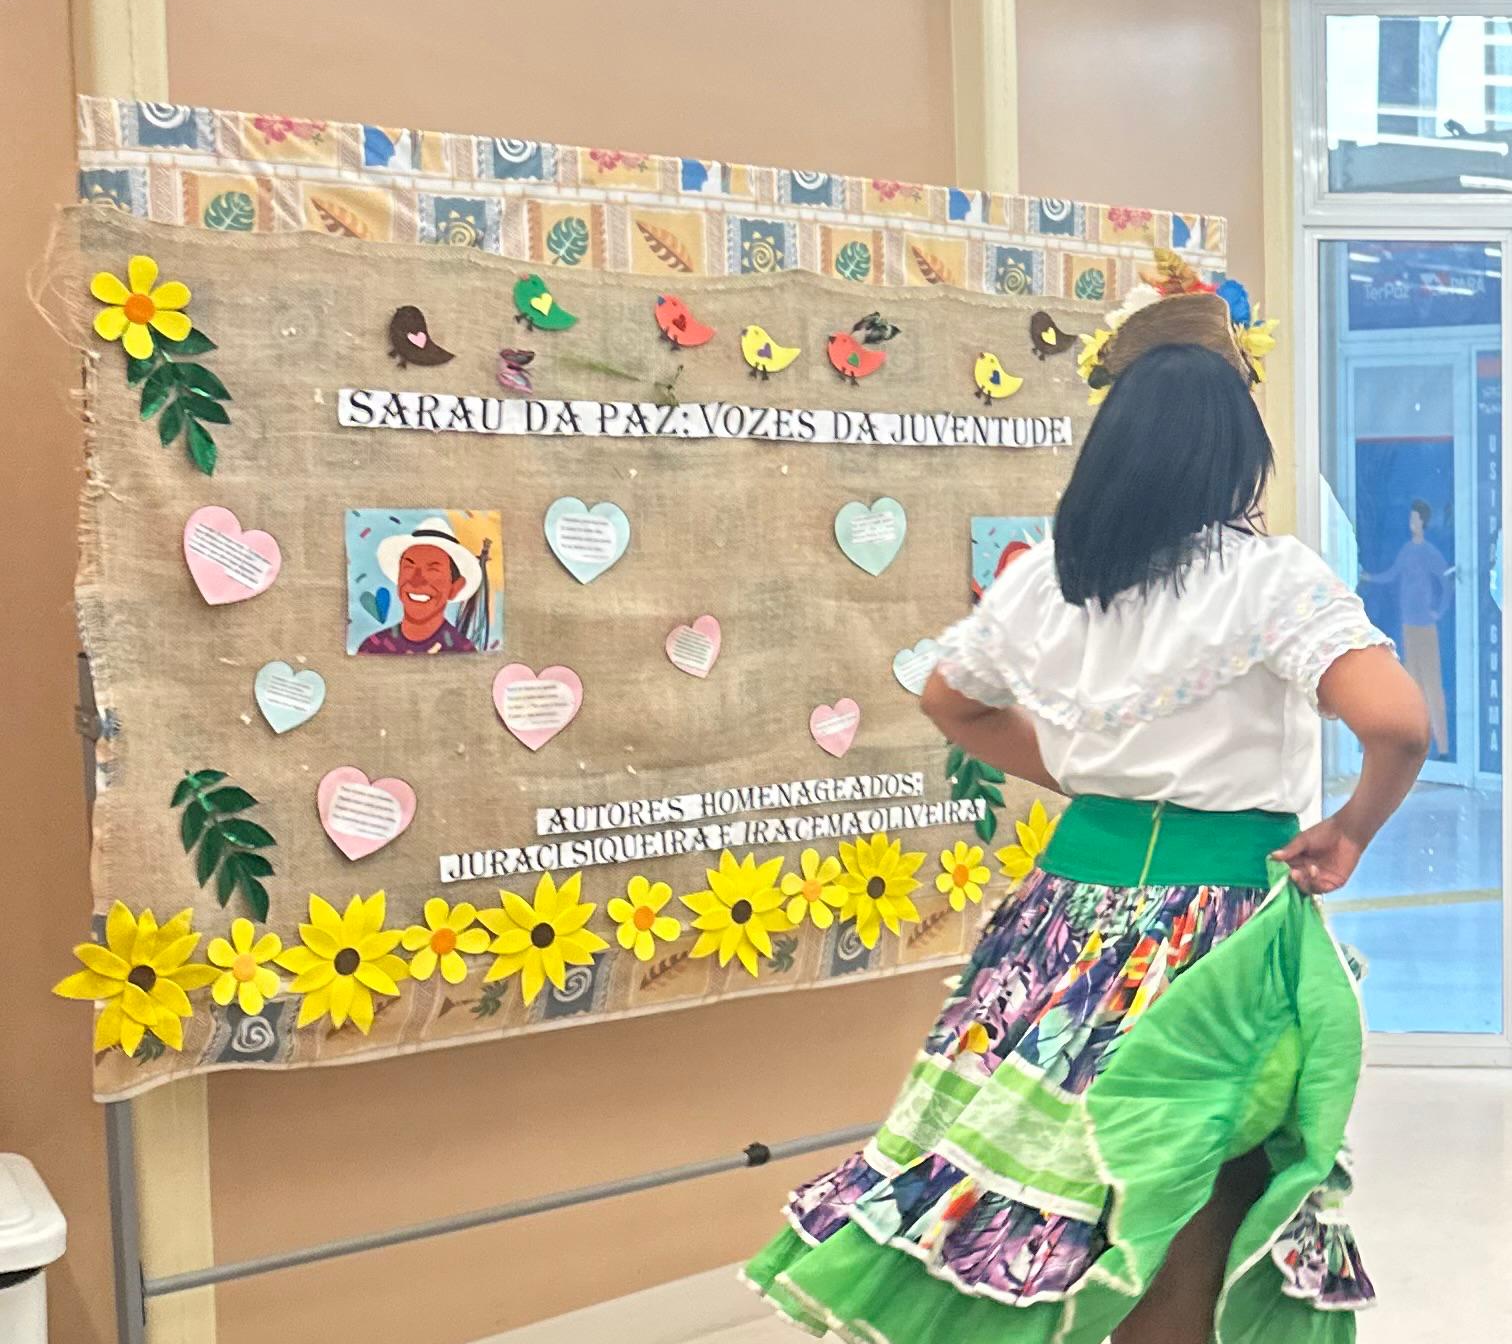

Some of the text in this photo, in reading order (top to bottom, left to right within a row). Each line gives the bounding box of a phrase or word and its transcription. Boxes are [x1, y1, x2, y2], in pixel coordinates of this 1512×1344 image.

[349, 390, 1067, 446] SARAU DA PAZ: VOZES DA JUVENTUDE
[548, 772, 922, 833] AUTORES HOMENAGEADOS:
[449, 798, 981, 879] JURACI SIQUEIRA E IRACEMA OLIVEIRA
